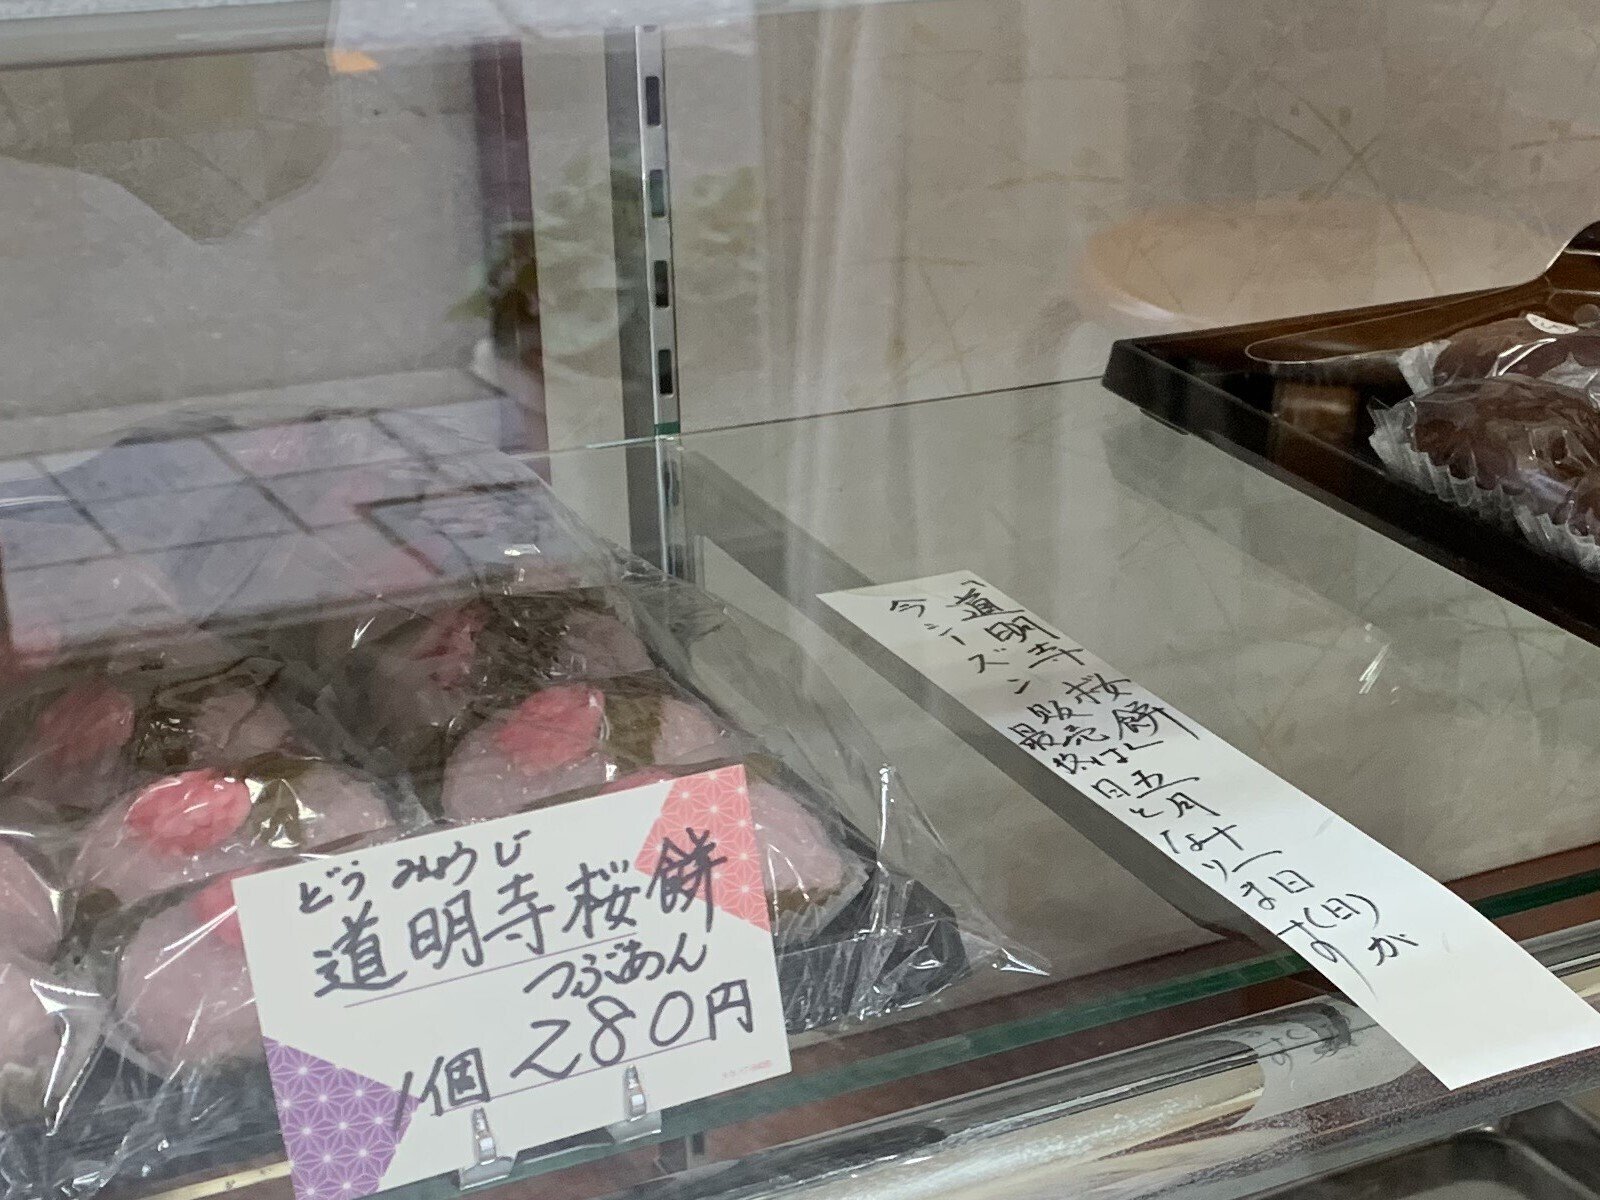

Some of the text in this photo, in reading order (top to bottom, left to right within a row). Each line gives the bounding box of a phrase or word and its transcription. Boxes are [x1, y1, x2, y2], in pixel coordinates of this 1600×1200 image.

[314, 827, 727, 996] 道明寺桜餅
[523, 932, 707, 998] つぶあん
